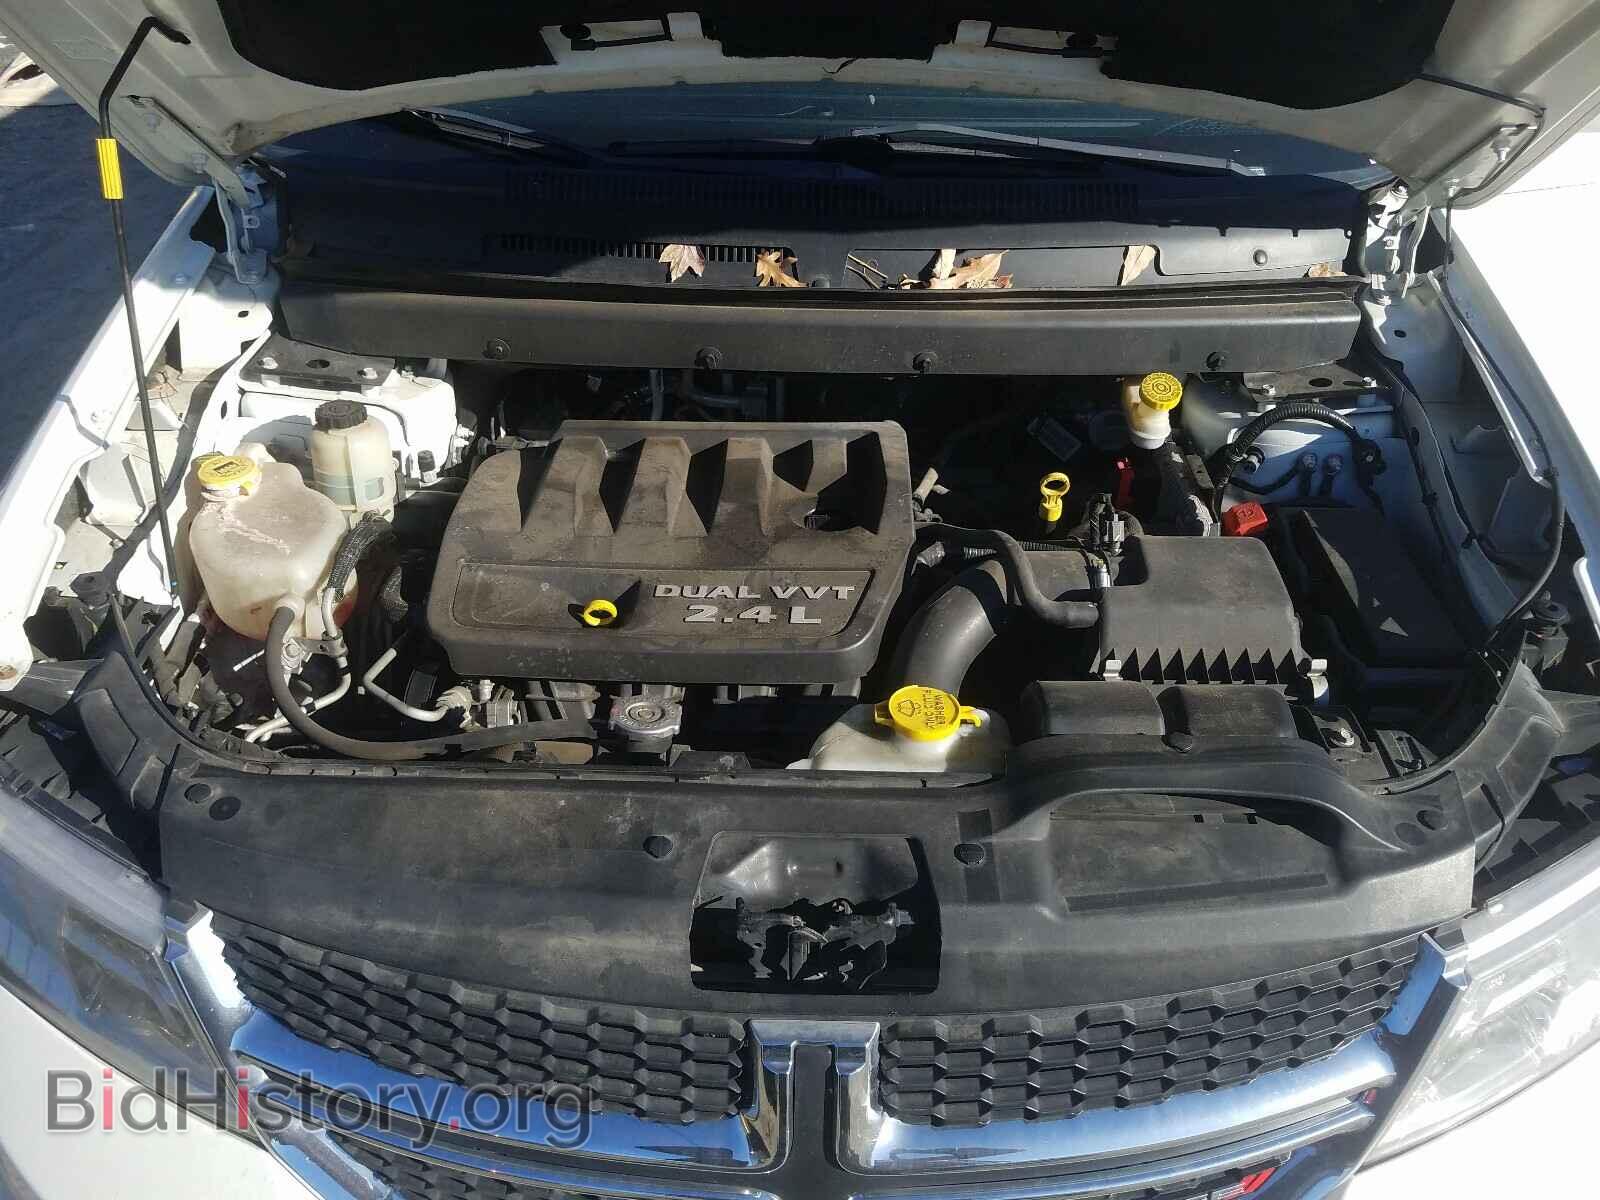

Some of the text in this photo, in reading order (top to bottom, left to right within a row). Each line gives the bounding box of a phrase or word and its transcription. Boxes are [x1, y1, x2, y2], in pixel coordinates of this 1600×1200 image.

[653, 584, 855, 600] DUAL VVT
[684, 604, 822, 625] 2.4 L
[922, 689, 937, 729] FLUID ONLY
[934, 694, 946, 725] WASHER
